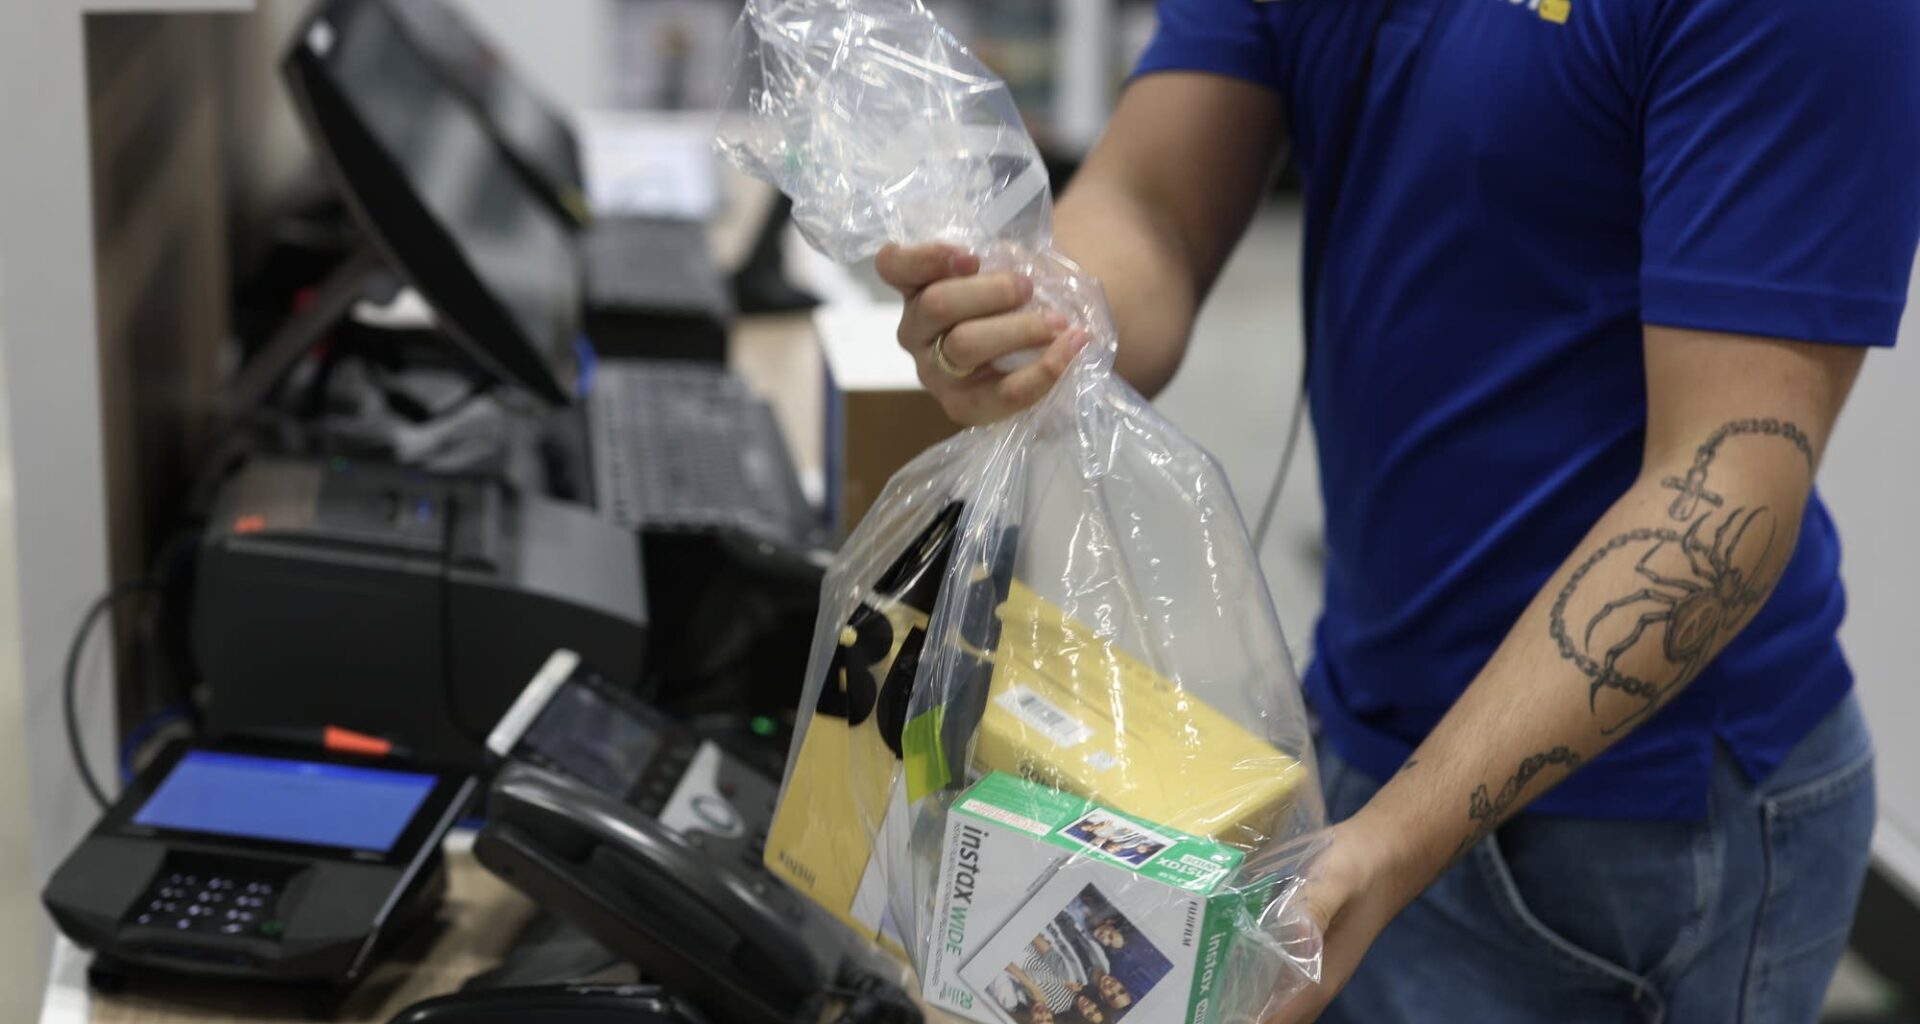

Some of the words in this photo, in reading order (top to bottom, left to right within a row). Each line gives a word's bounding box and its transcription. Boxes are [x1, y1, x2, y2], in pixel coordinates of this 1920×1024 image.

[953, 824, 989, 904] instax
[946, 906, 967, 956] WIDE
[1182, 900, 1198, 947] FUJIFILM
[1199, 931, 1227, 996] instax
